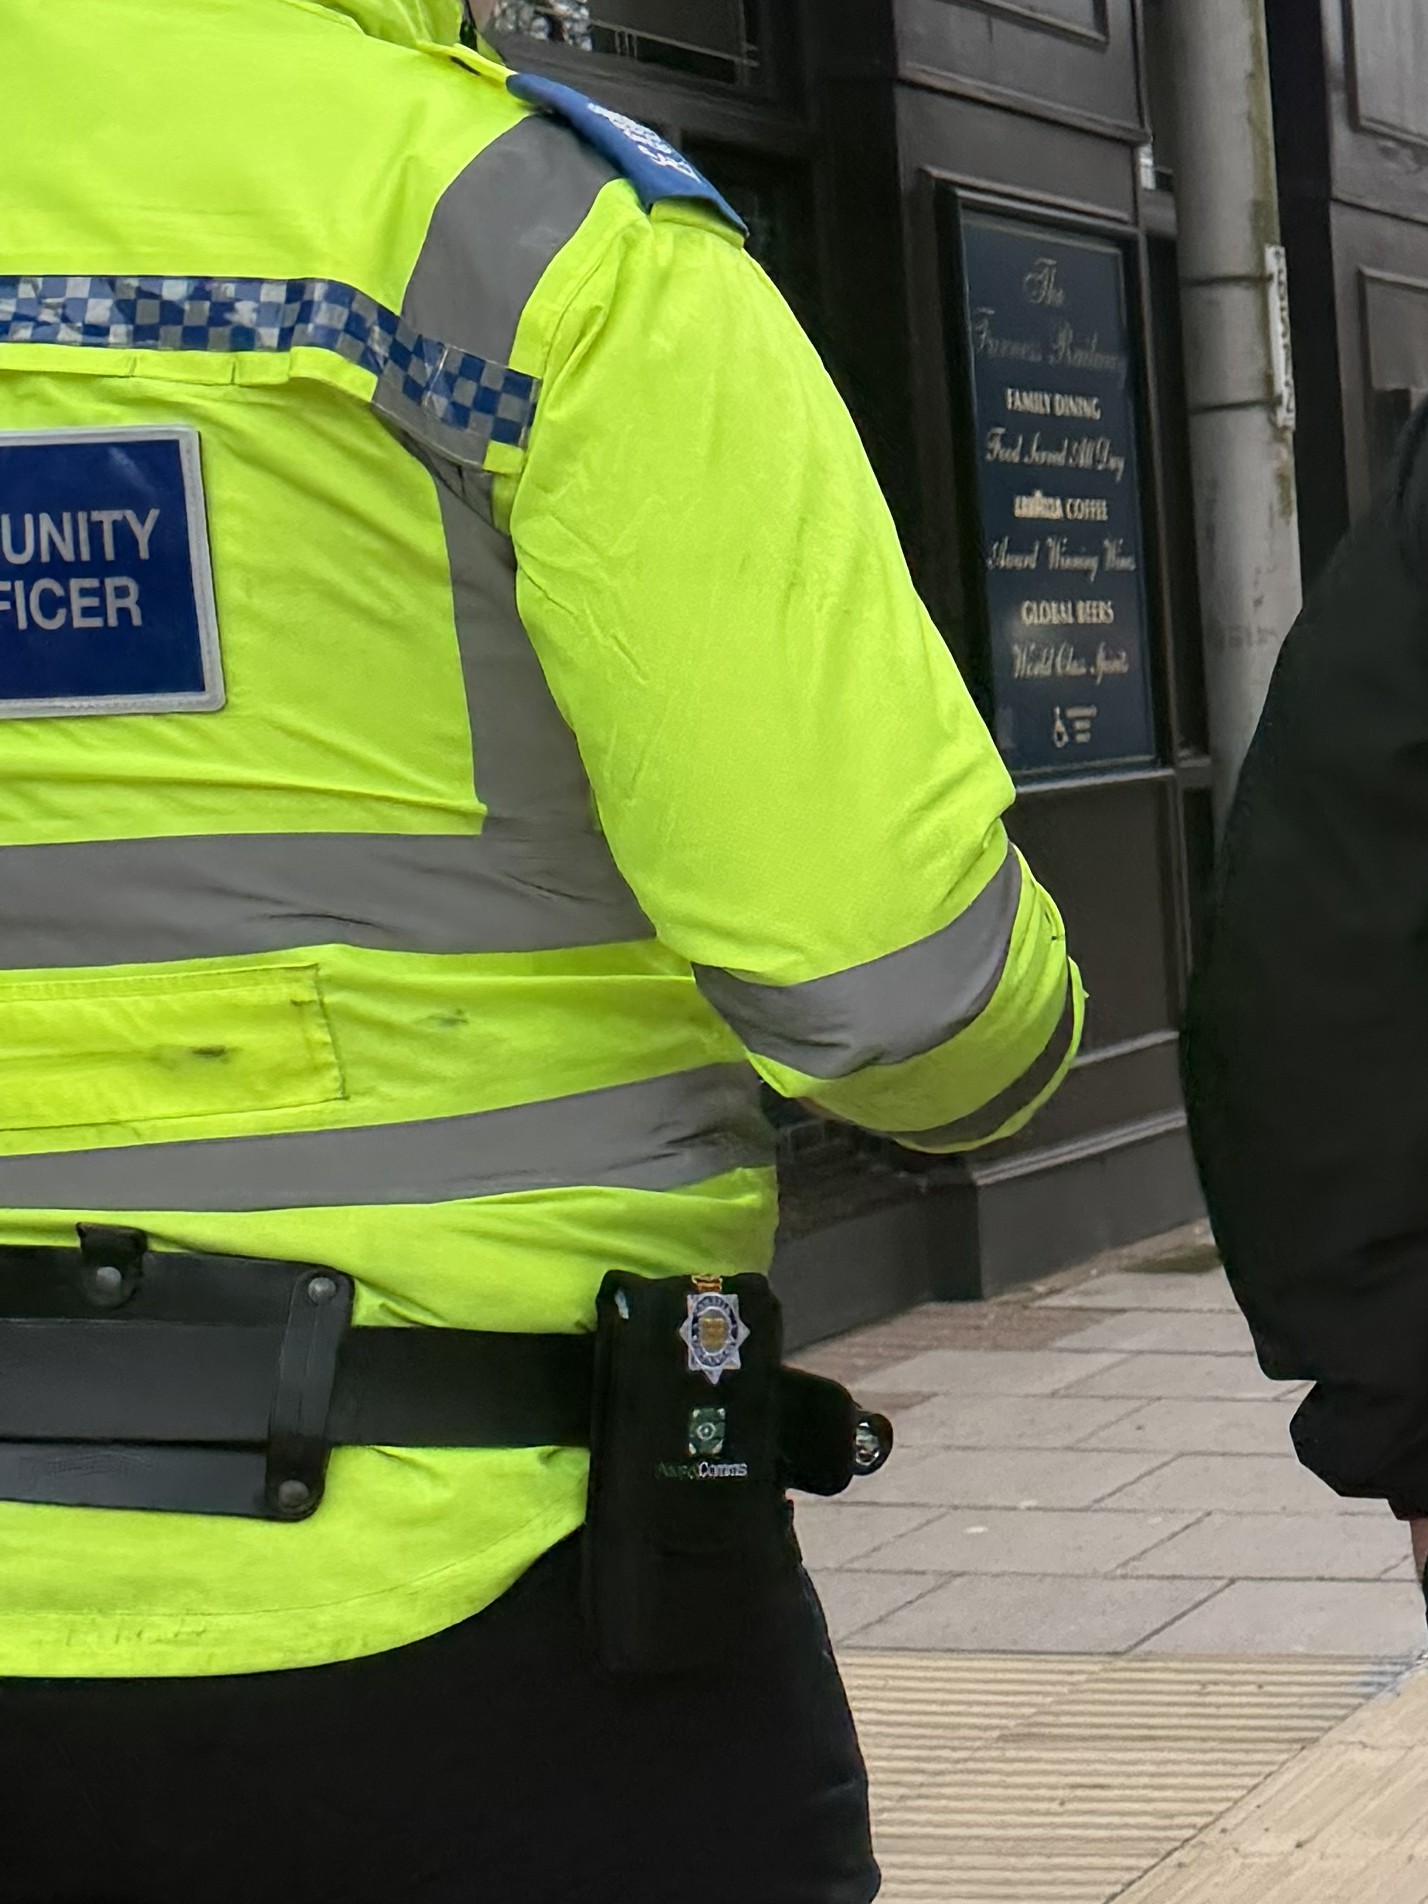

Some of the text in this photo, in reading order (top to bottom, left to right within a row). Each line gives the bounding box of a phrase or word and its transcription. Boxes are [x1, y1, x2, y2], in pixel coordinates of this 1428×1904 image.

[1022, 256, 1067, 308] The
[1006, 387, 1102, 421] FAMILY DINING
[983, 426, 1024, 464] Food
[1094, 437, 1126, 483] Day
[1066, 497, 1108, 521] COFFEE
[0, 508, 160, 565] UNITY
[1020, 599, 1115, 625] GLOBAL BEERS
[1012, 642, 1055, 679] World
